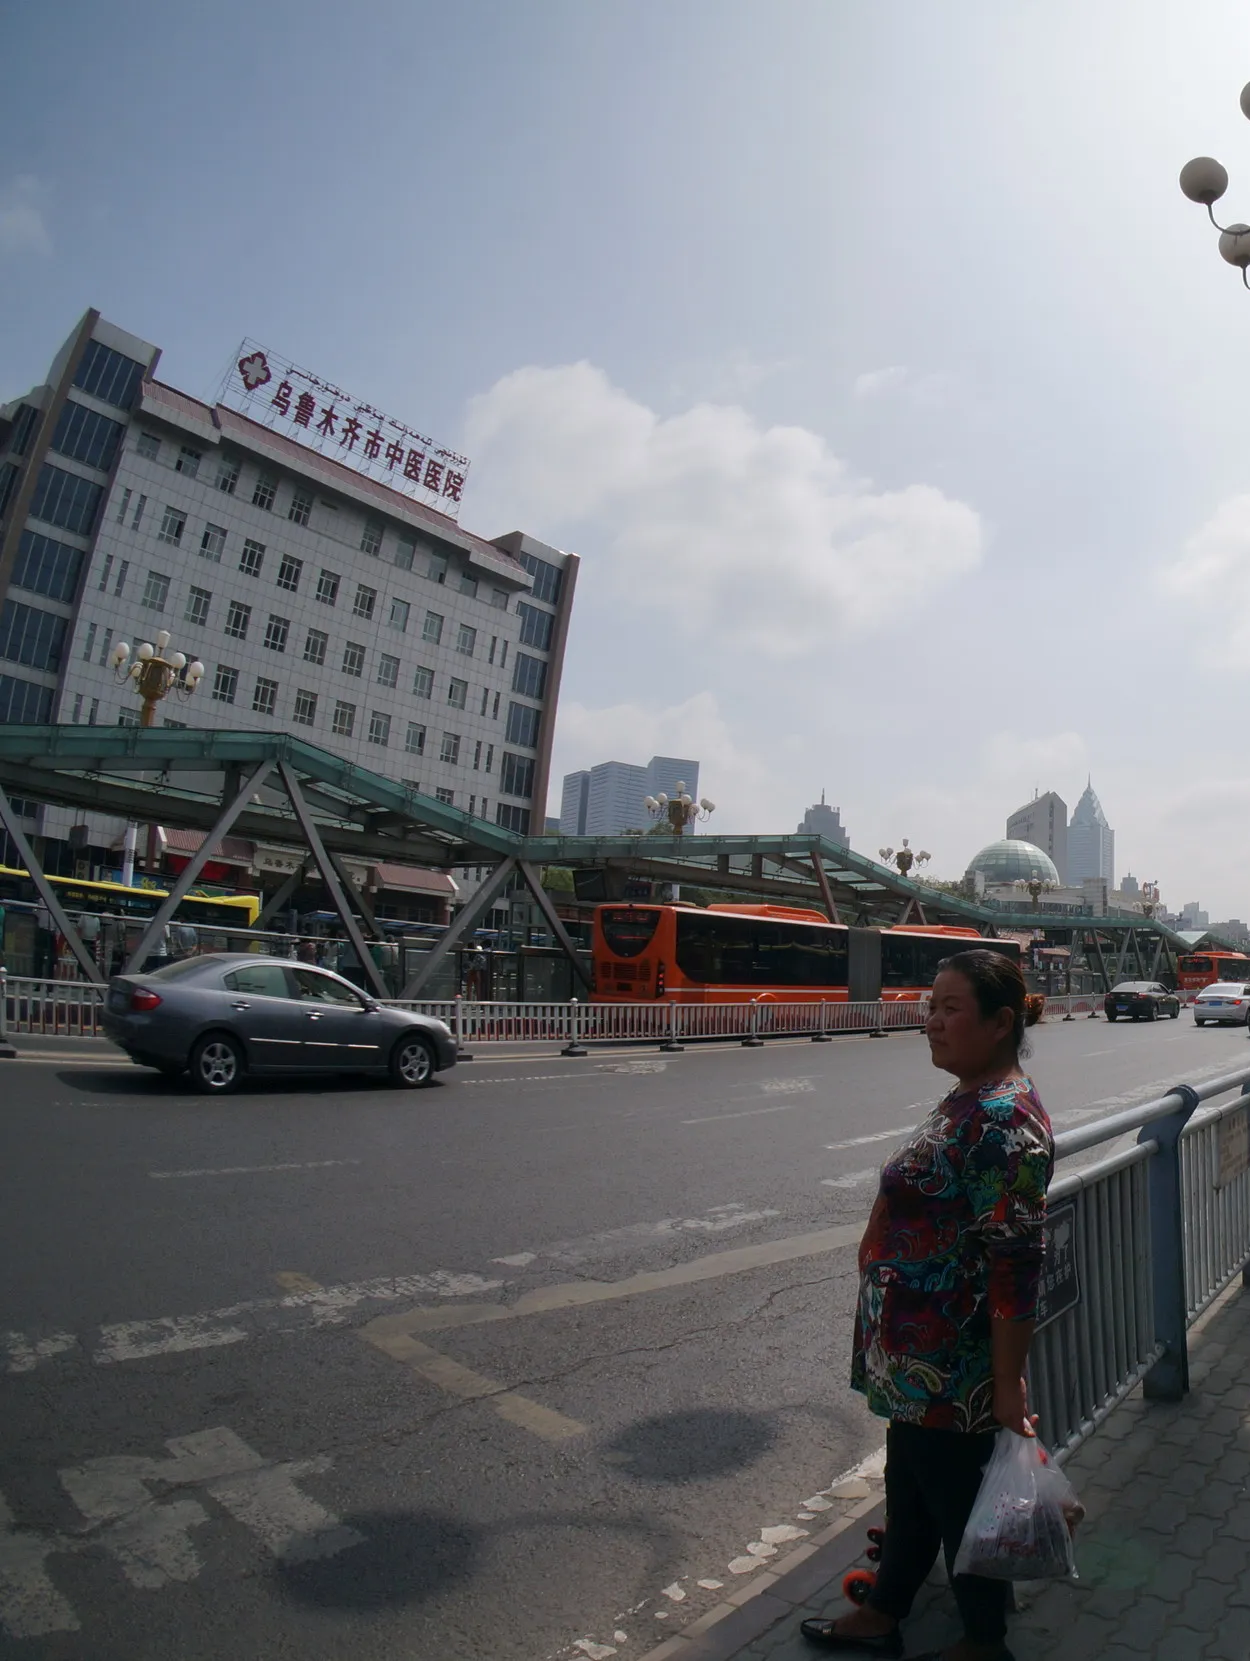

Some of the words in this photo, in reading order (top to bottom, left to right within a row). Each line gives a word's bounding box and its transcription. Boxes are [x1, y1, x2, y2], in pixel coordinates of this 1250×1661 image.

[271, 380, 464, 502] 乌鲁木齐市中医医院
